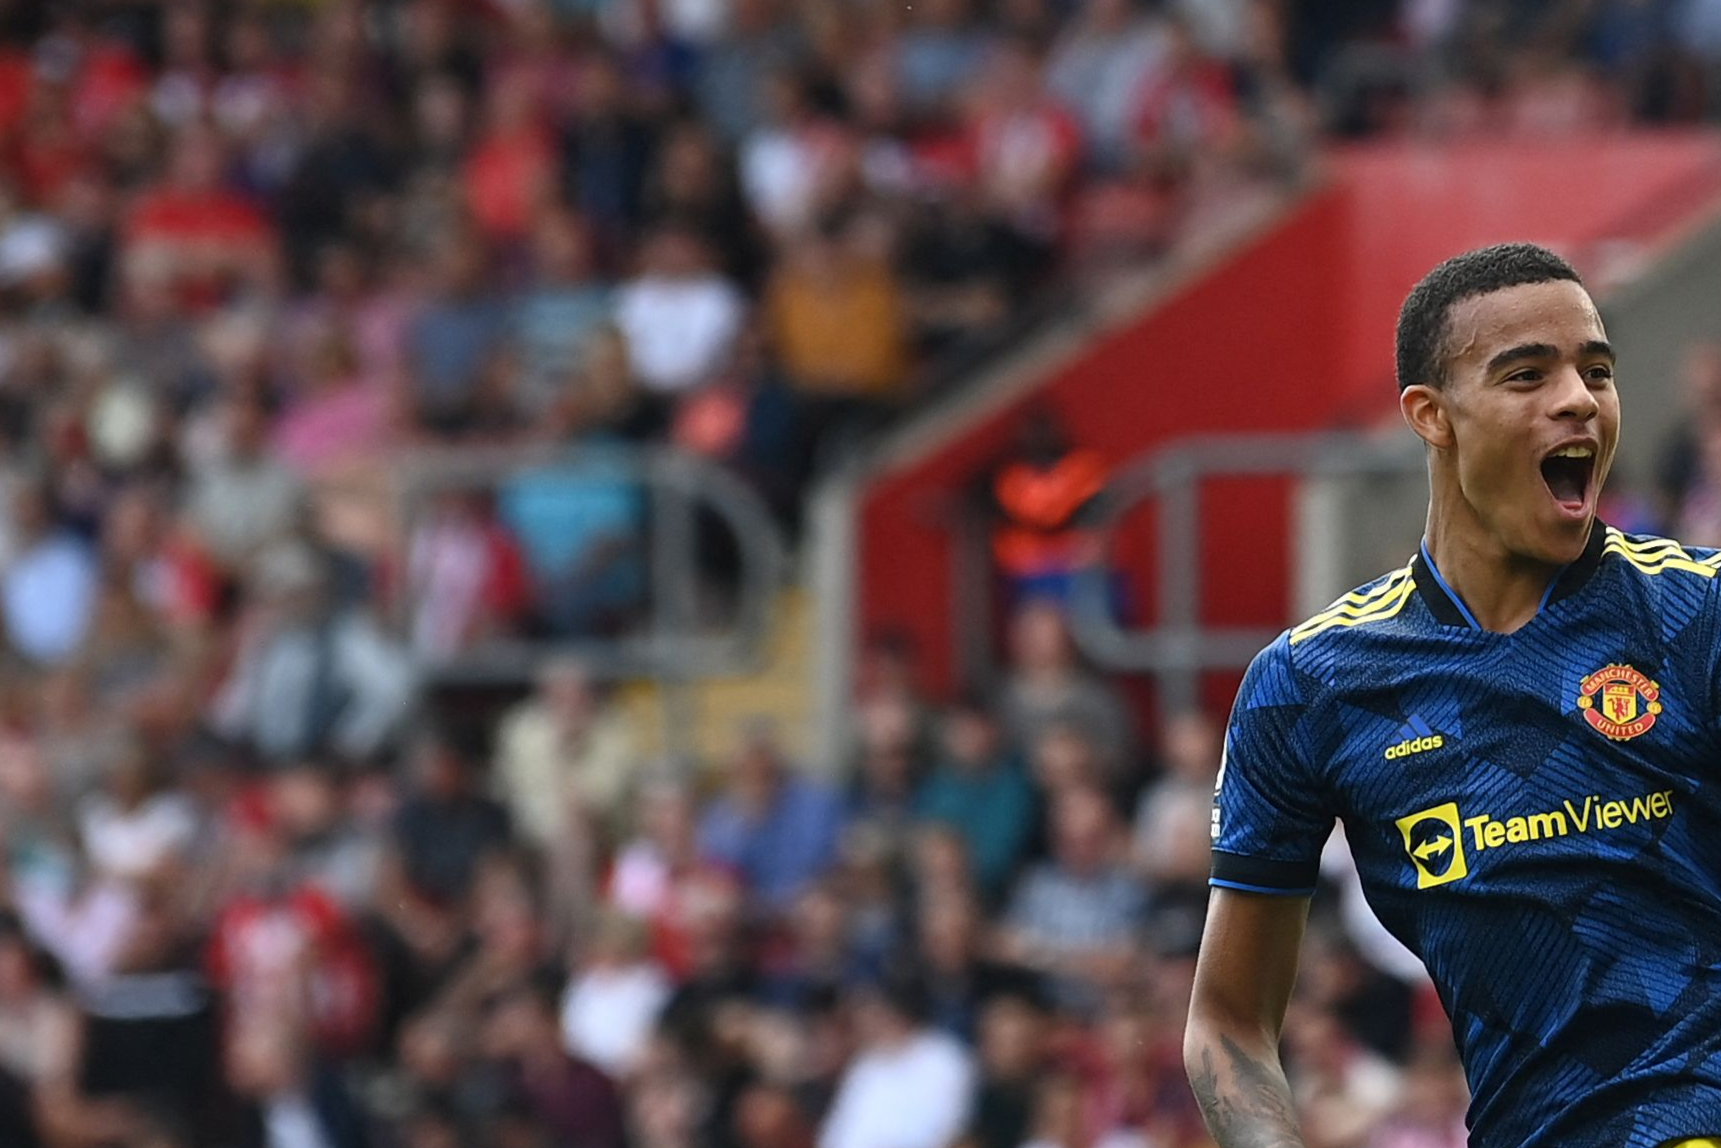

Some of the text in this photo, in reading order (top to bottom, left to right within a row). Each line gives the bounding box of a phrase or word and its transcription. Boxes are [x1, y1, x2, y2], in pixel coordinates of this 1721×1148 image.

[1585, 668, 1654, 698] MANCHESTER
[1596, 719, 1644, 736] UNITED
[1384, 735, 1443, 760] adidas
[1464, 789, 1674, 851] TeamViewer
